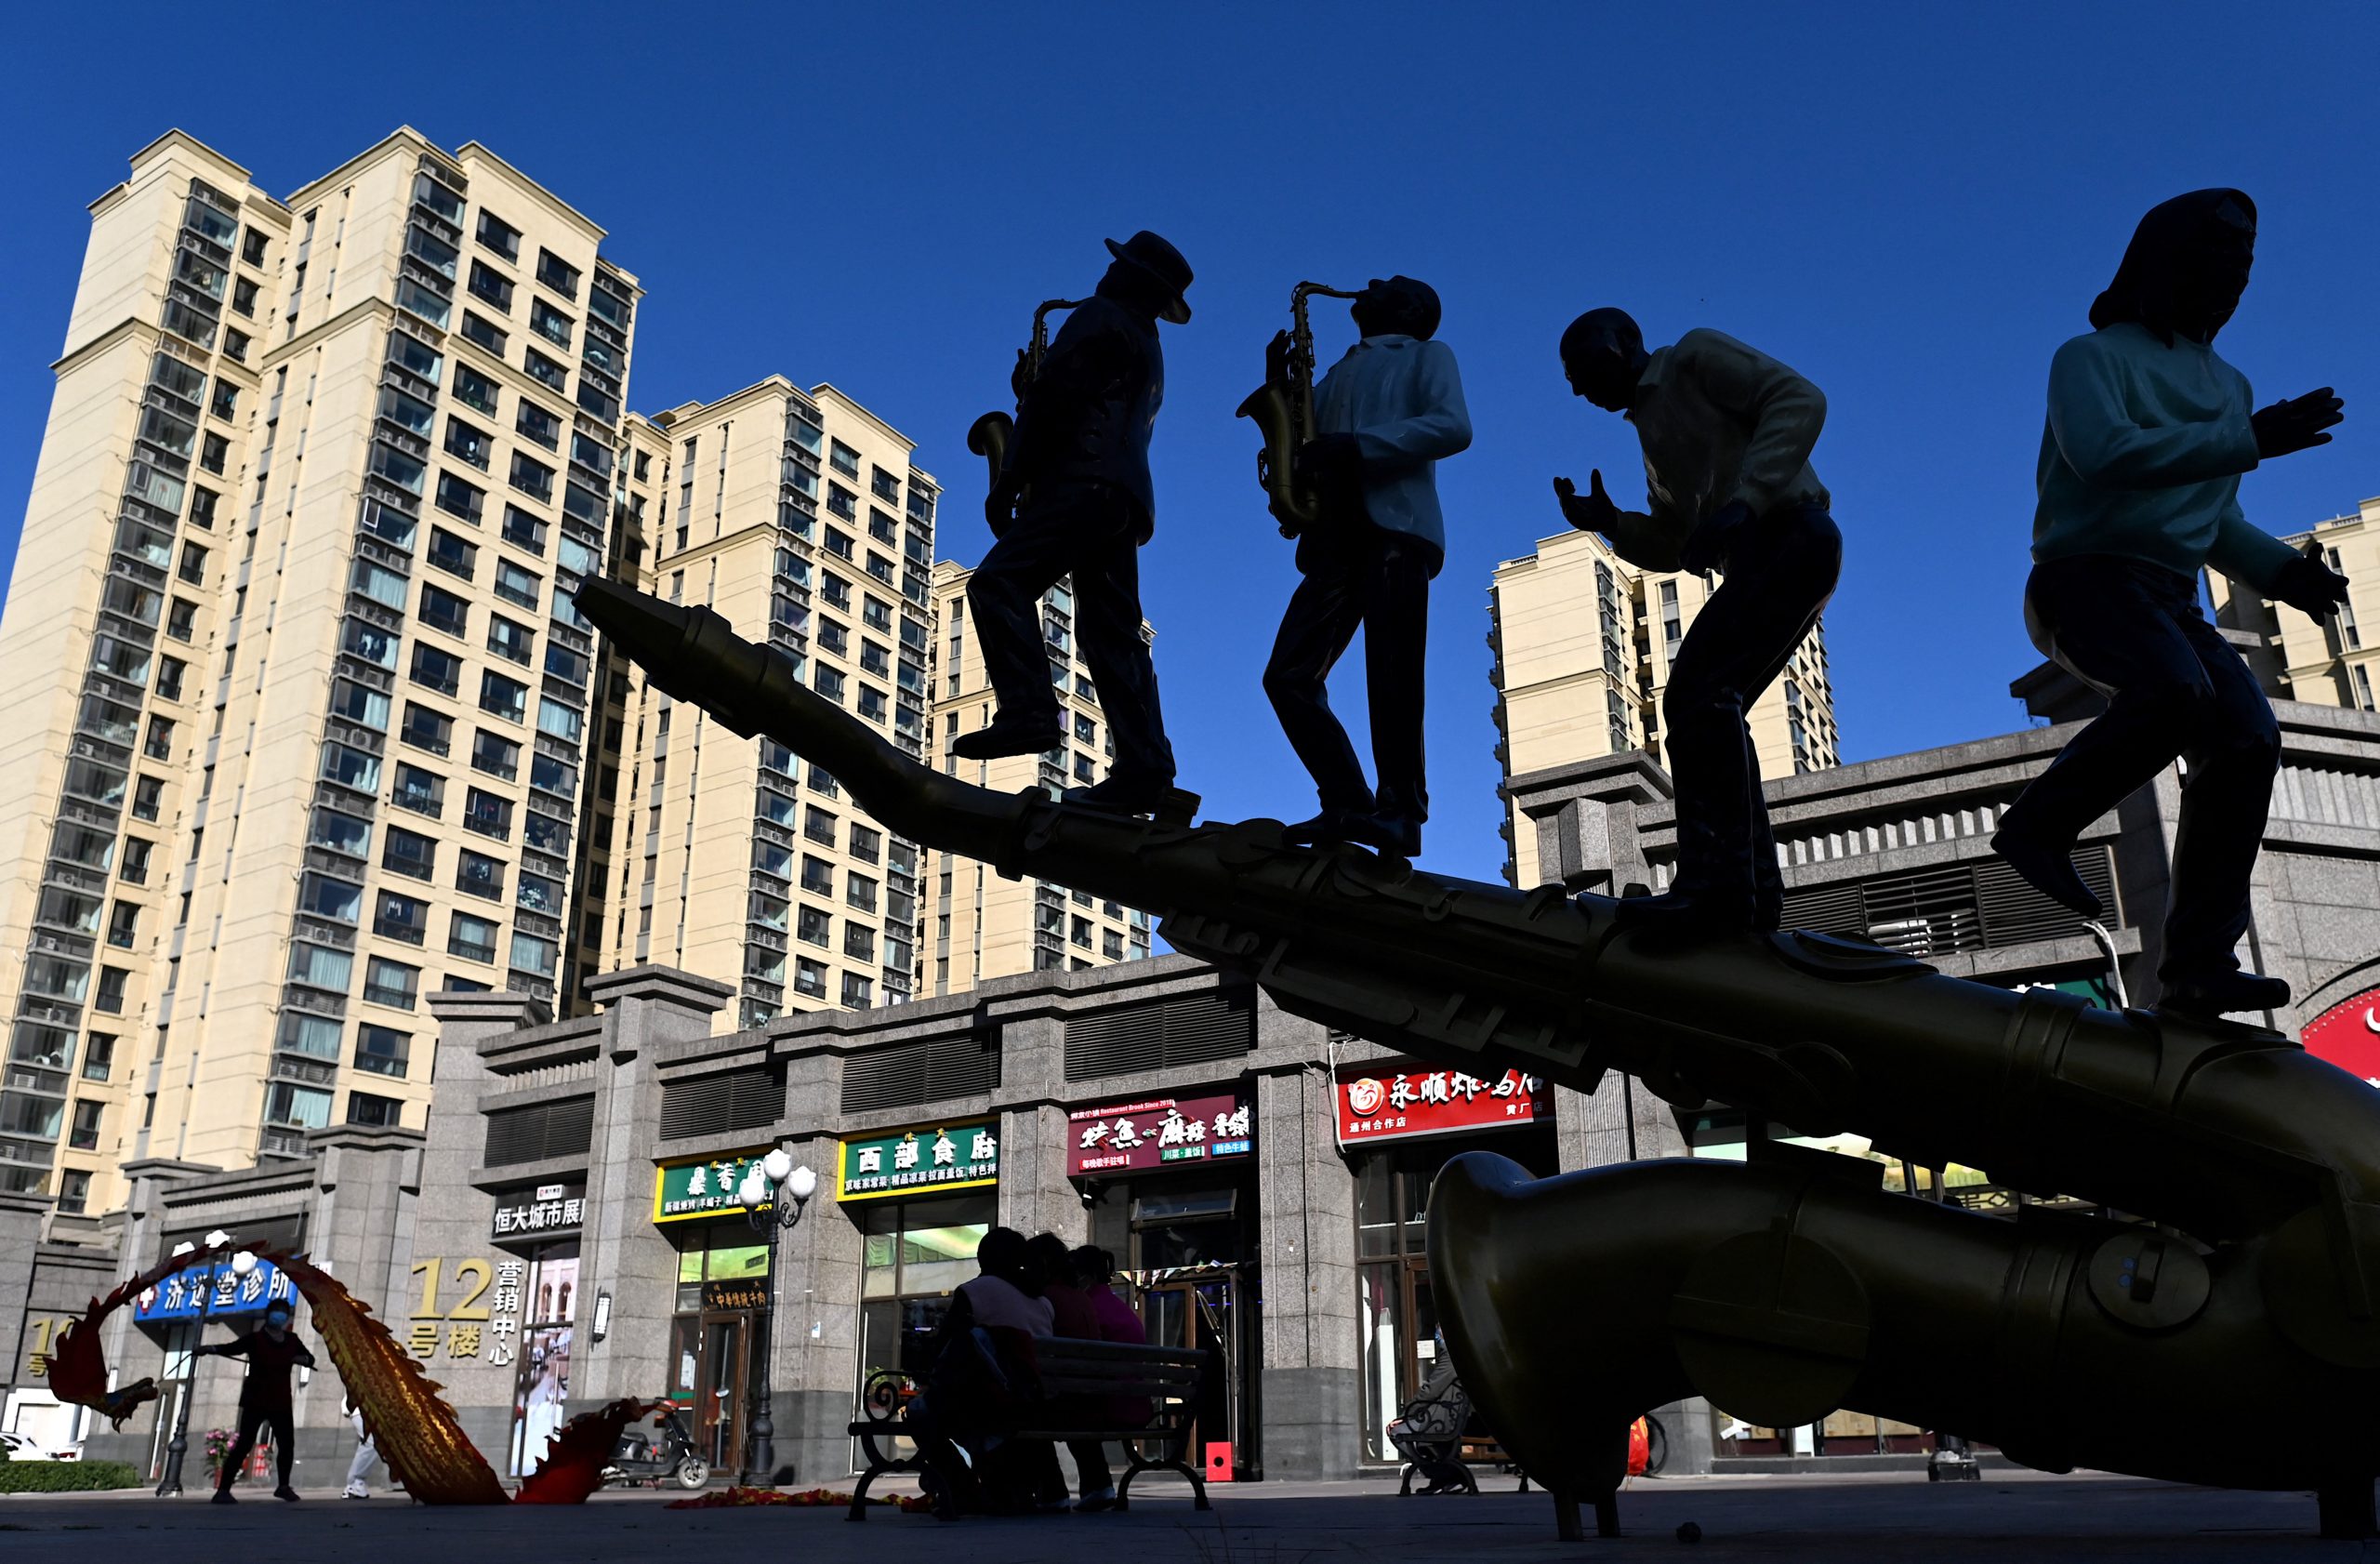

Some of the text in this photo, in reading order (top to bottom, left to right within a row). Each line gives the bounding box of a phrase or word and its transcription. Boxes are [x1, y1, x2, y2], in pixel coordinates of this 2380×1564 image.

[1349, 1117, 1407, 1133] 通州合作店
[858, 1131, 998, 1173] 西部食府
[495, 1199, 586, 1233] 恒大城市展
[410, 1257, 493, 1320] 12
[488, 1261, 522, 1366] 营销中心
[408, 1323, 480, 1358] 号楼
